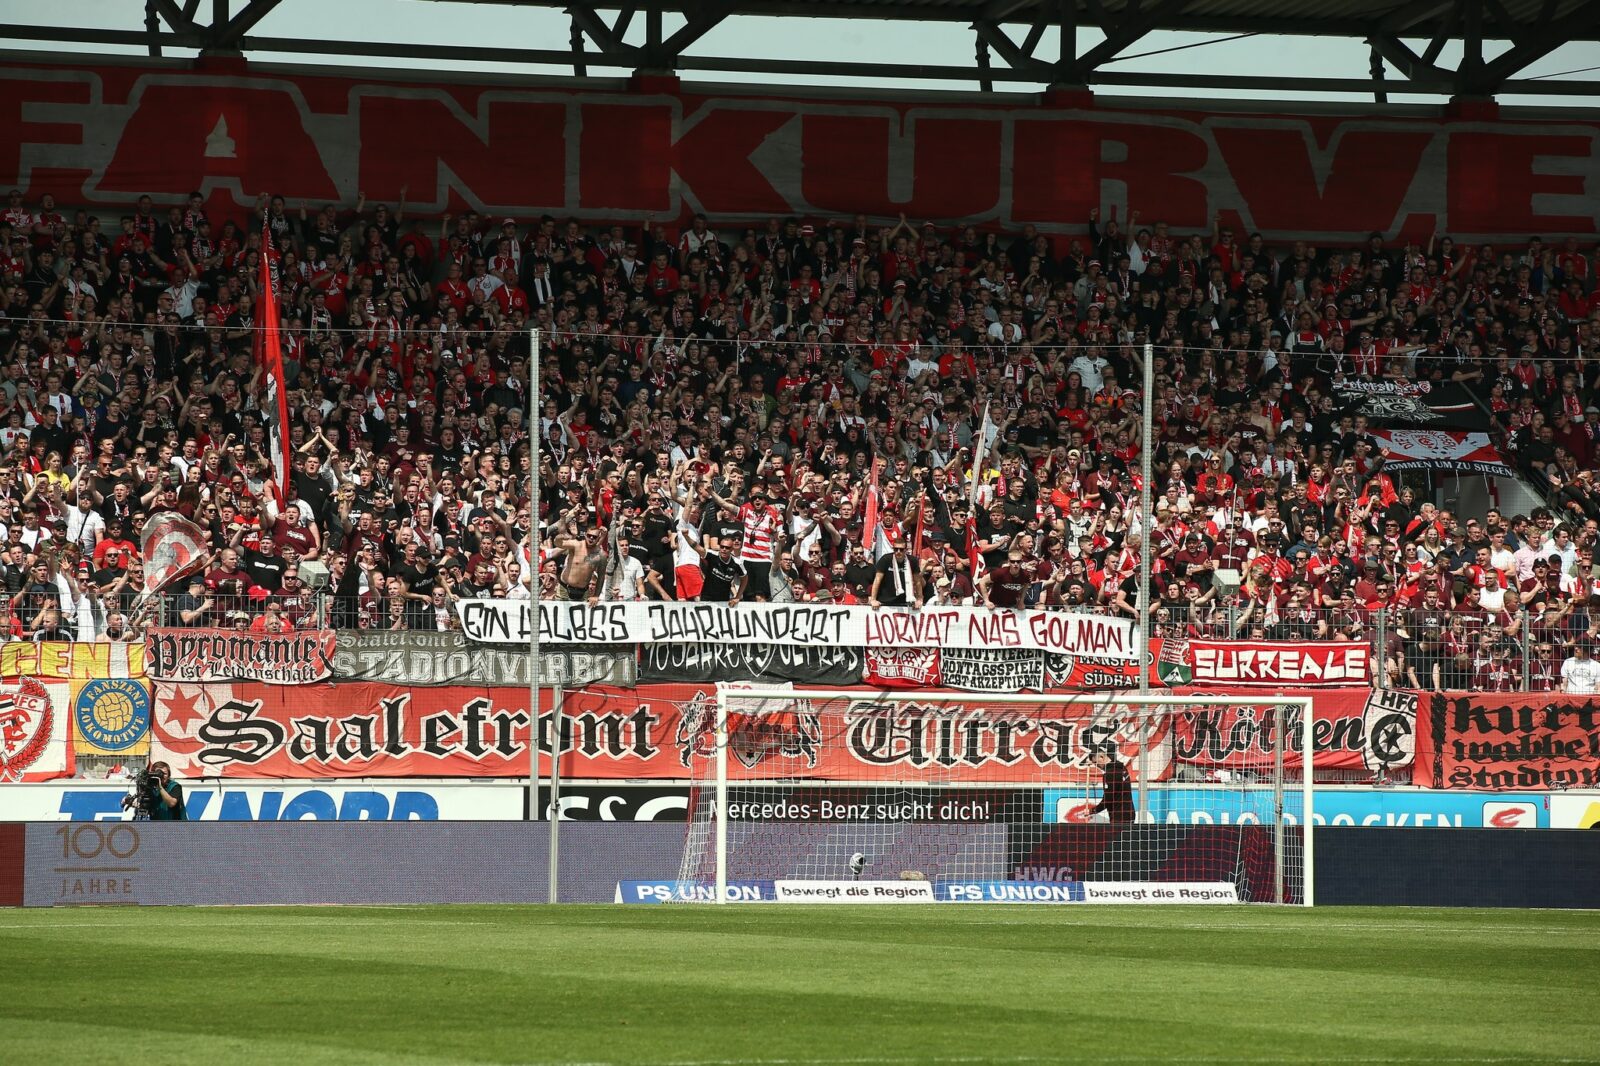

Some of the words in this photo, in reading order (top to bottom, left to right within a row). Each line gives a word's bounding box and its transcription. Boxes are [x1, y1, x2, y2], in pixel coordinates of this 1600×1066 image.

[1384, 461, 1432, 471] KOMMEN
[1435, 461, 1453, 469] UM
[1456, 462, 1471, 470] ZU
[1474, 463, 1513, 477] SIEGEN
[464, 602, 508, 640] EIN
[520, 604, 629, 641] HALBES
[651, 604, 850, 642] JAHRHUNDERT
[866, 610, 959, 646] HORVAT
[149, 633, 317, 677] Pyromanie
[1194, 649, 1366, 680] SURREALE
[181, 665, 201, 679] ist
[209, 661, 315, 682] Leidenschaft
[334, 649, 635, 684] STADIONVERBOT
[942, 659, 1042, 676] MONTAGSSPIELE
[1084, 670, 1140, 687] SÜDHAR
[85, 679, 146, 708] FANSZENE
[1381, 690, 1418, 713] HFC
[80, 707, 146, 745] LOKOMOTIVE
[198, 692, 661, 765] Saalefront
[877, 801, 933, 819] sucht
[940, 801, 990, 820] dich!
[57, 823, 140, 859] 100
[61, 878, 133, 897] JAHRE
[637, 885, 670, 900] PS
[678, 885, 761, 900] UNON
[782, 886, 841, 898] bewegt
[846, 886, 868, 897] die
[874, 886, 928, 898] Region
[949, 885, 982, 900] PS
[991, 885, 1071, 900] UNION
[1089, 888, 1147, 899] bewegt
[1152, 888, 1175, 898] die
[1179, 888, 1233, 900] Region
